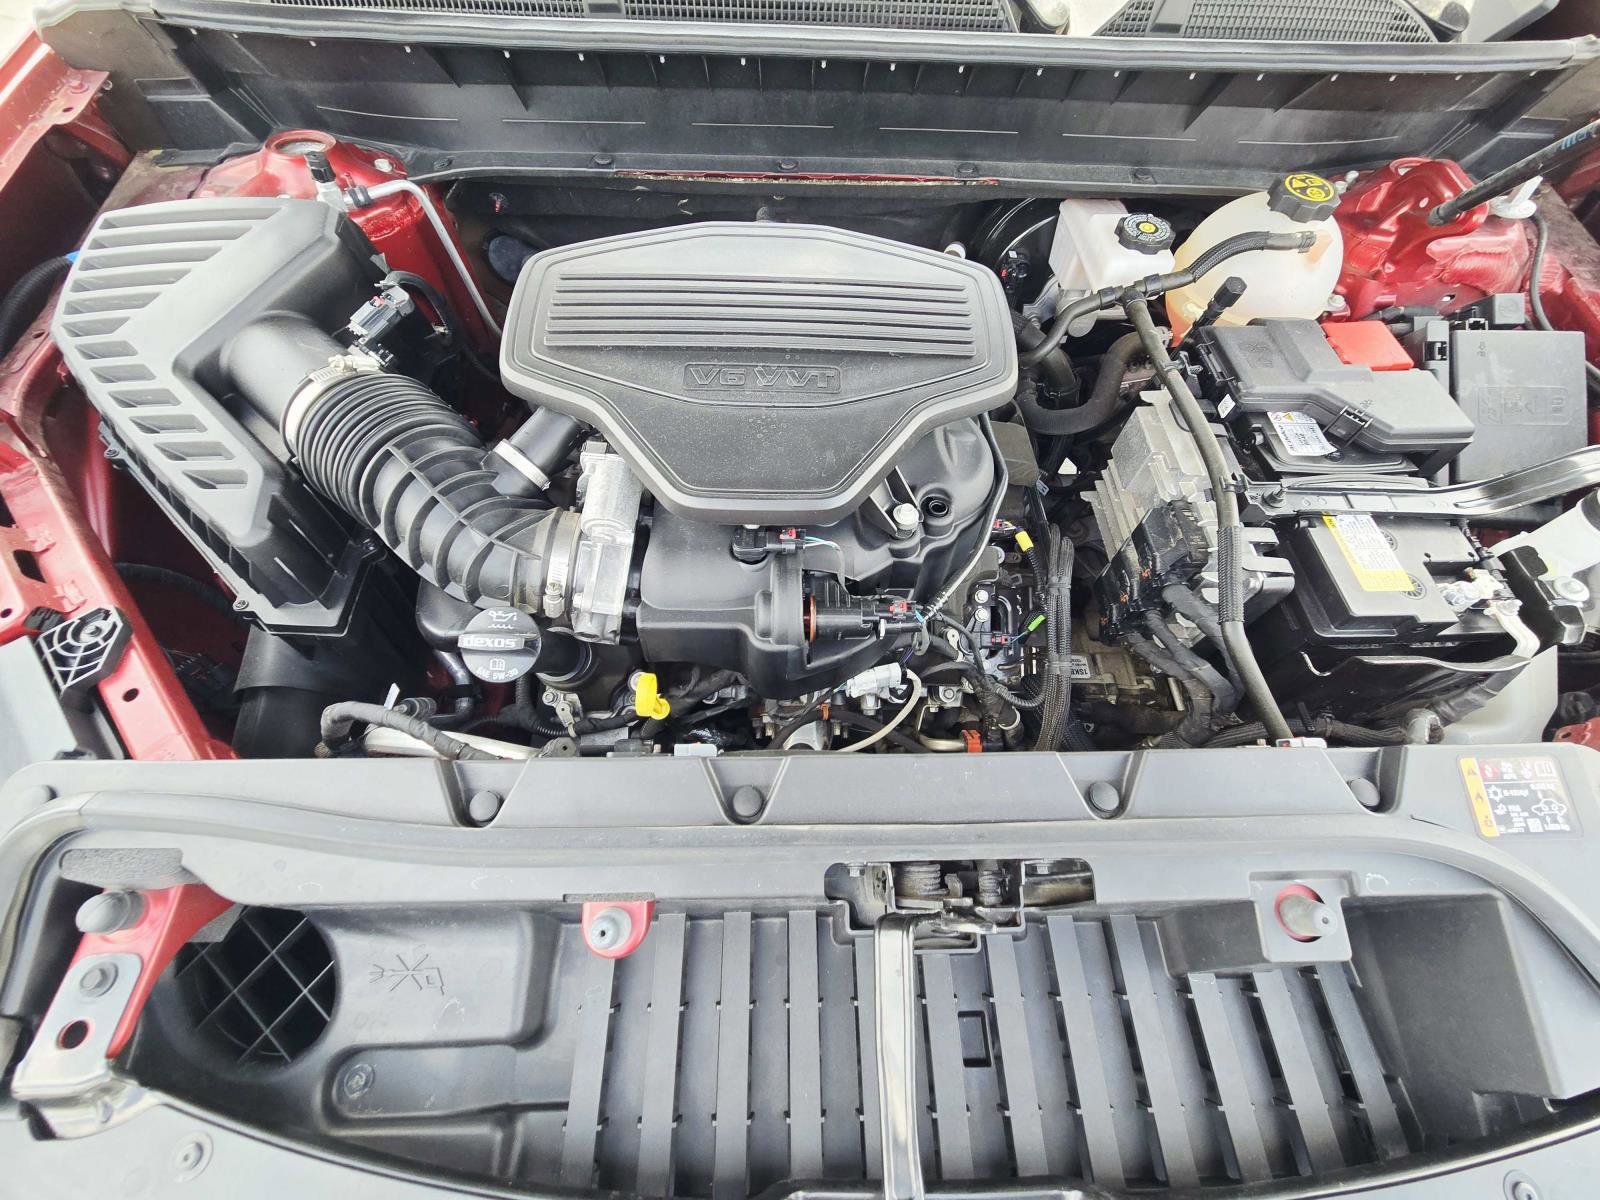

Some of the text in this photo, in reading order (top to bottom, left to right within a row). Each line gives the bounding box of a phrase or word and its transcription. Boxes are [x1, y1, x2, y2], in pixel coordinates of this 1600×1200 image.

[690, 367, 835, 388] V6 VVT
[463, 635, 516, 648] dexos
[492, 667, 519, 680] 5W-30
